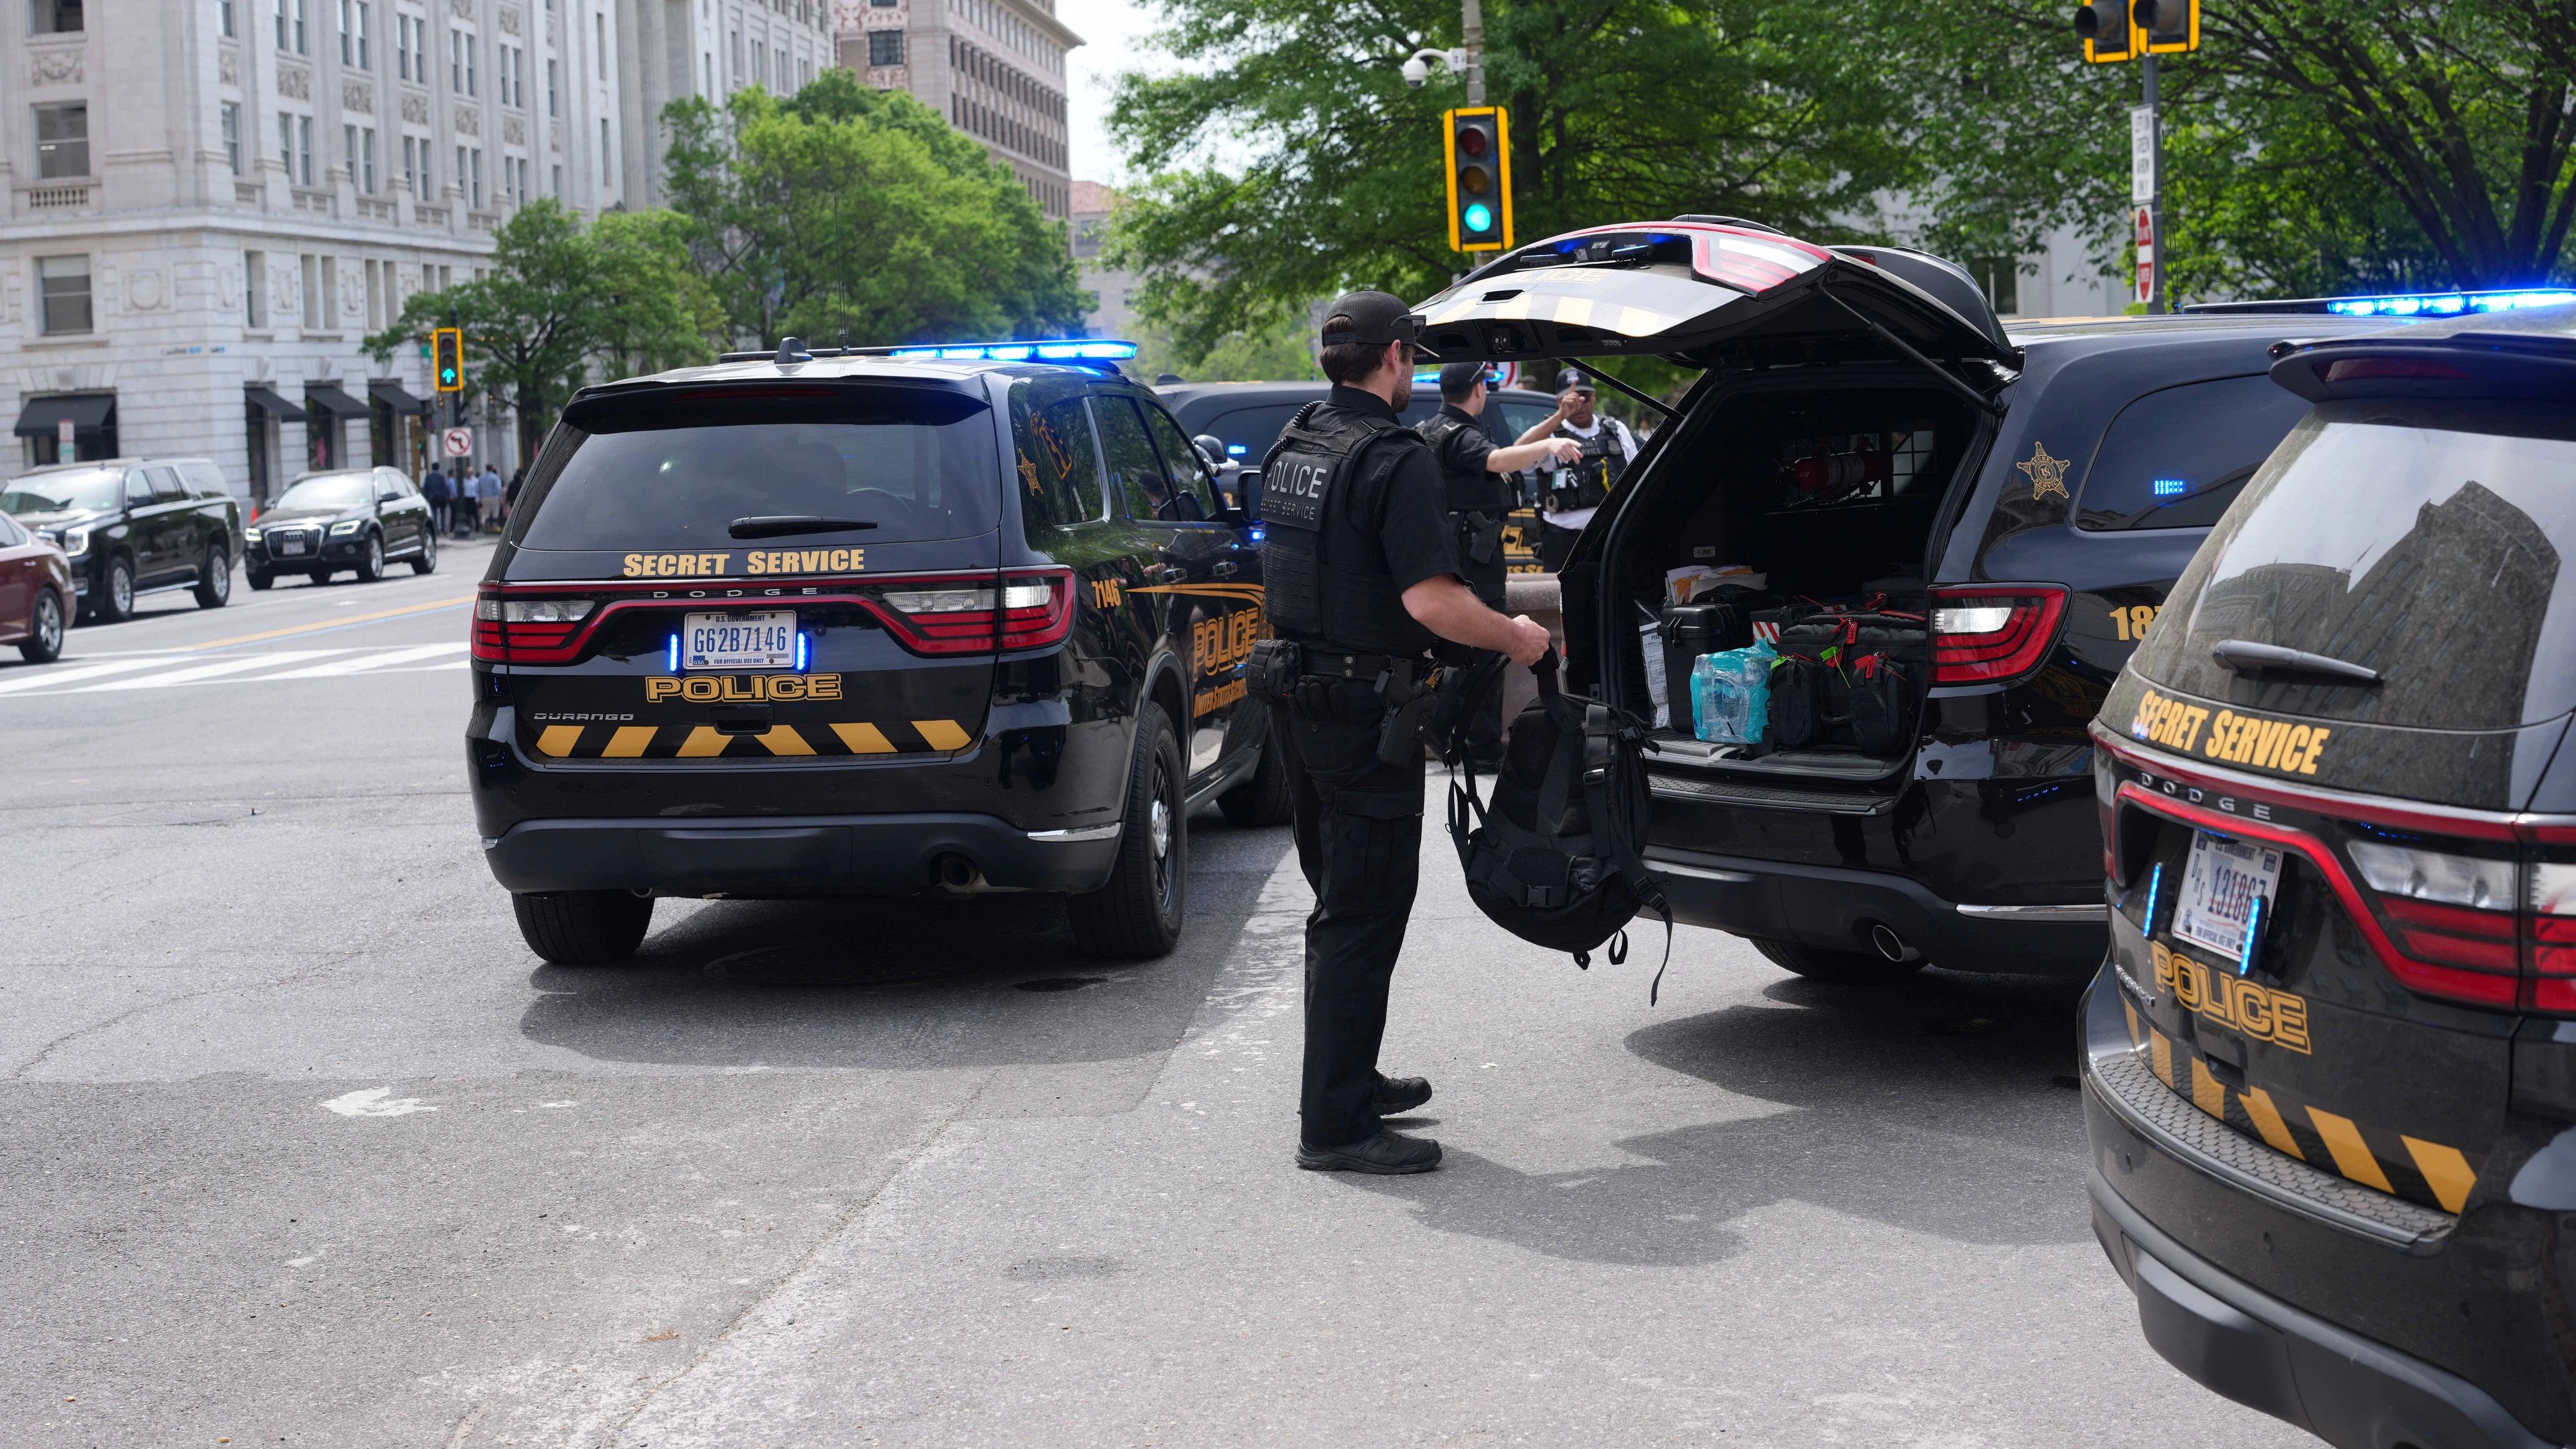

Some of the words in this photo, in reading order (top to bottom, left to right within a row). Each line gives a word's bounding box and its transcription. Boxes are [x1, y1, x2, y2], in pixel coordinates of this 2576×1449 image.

[2031, 456, 2055, 467] SECRET
[2035, 477, 2060, 489] SERVICE
[1261, 498, 1281, 514] SECRET
[1282, 502, 1315, 520] SERVICE
[623, 552, 730, 577] SECRET
[747, 549, 865, 574] SERVICE
[653, 587, 819, 598] DODGE
[1092, 578, 1121, 609] 7146
[727, 614, 766, 623] GOVERNMENT
[694, 627, 786, 652] G62B7146
[1193, 607, 1259, 683] POLICE
[645, 674, 842, 703] POLICE
[2132, 690, 2210, 752] SECRET
[2205, 710, 2331, 775] SERVICE
[2139, 772, 2271, 820] DODGE
[2151, 940, 2312, 1056] POLICE
